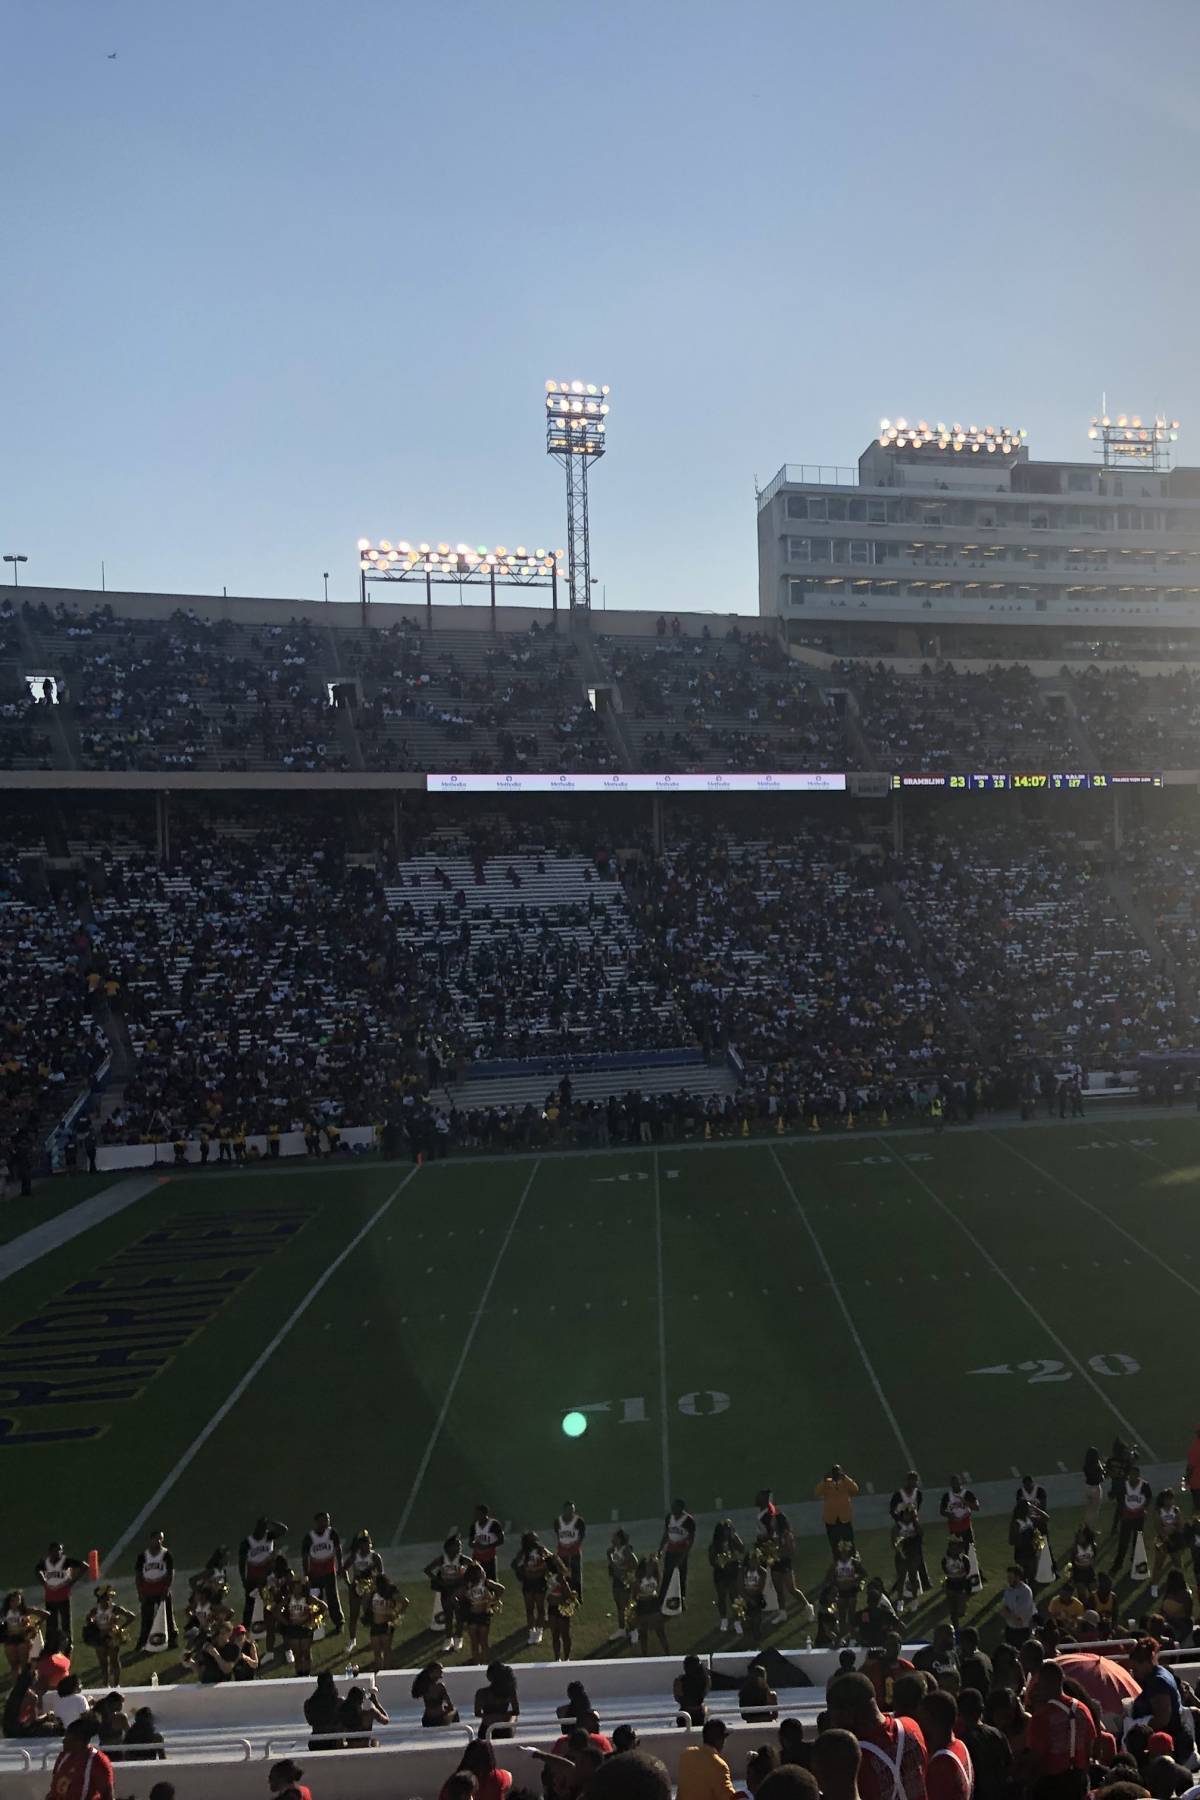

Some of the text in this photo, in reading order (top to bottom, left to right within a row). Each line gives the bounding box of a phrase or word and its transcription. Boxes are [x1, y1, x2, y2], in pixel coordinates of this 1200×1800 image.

[903, 777, 946, 786] GRAMBLING
[949, 776, 966, 788] 23
[1014, 775, 1047, 788] 14:07
[1093, 775, 1107, 787] 31
[1017, 1353, 1142, 1384] 20
[618, 1390, 732, 1424] 10
